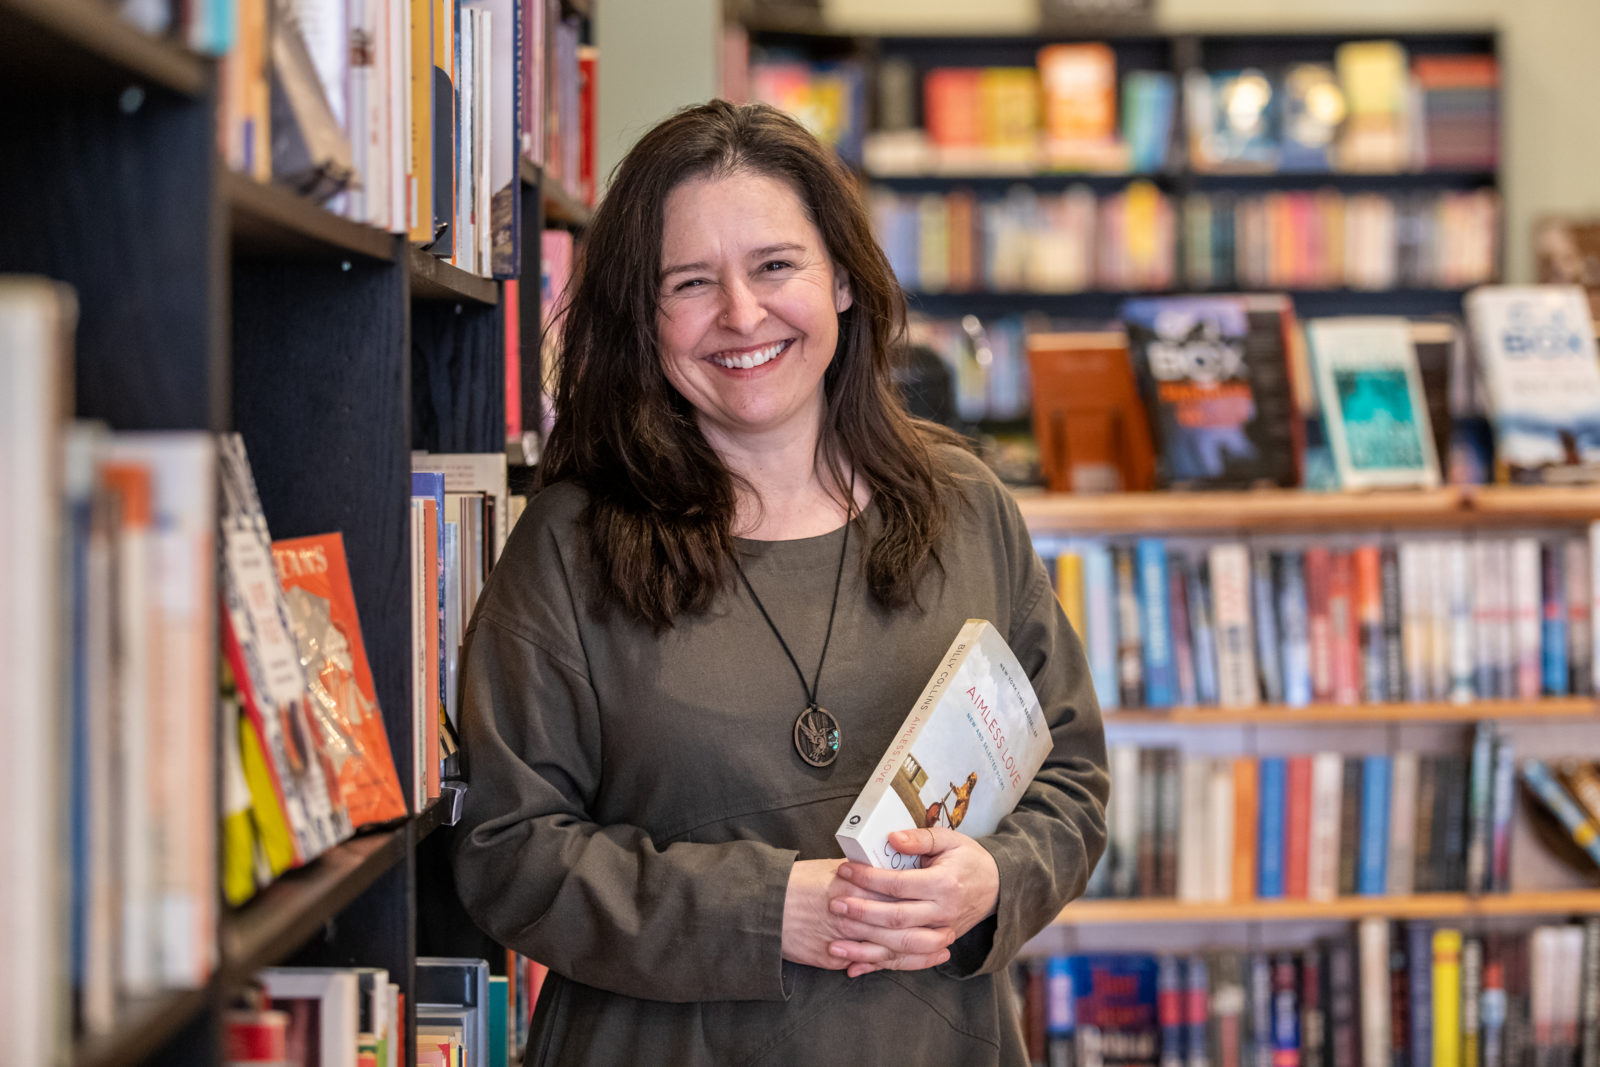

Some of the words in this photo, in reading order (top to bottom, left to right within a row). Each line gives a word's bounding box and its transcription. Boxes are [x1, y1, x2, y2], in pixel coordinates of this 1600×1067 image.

[947, 643, 966, 669] BILLY
[920, 671, 949, 711] COLLINS
[999, 663, 1008, 676] NEW
[1008, 677, 1018, 691] YORK
[1017, 691, 1026, 708] TIMES
[893, 716, 921, 756] AIMLESS
[966, 686, 1006, 749] AIMLESS
[1001, 747, 1022, 790] LOVE
[966, 712, 977, 728] NEW
[975, 728, 985, 742] AND
[983, 741, 998, 772] SELECTED
[995, 770, 1006, 791] POEMS
[875, 758, 896, 784] LOVE
